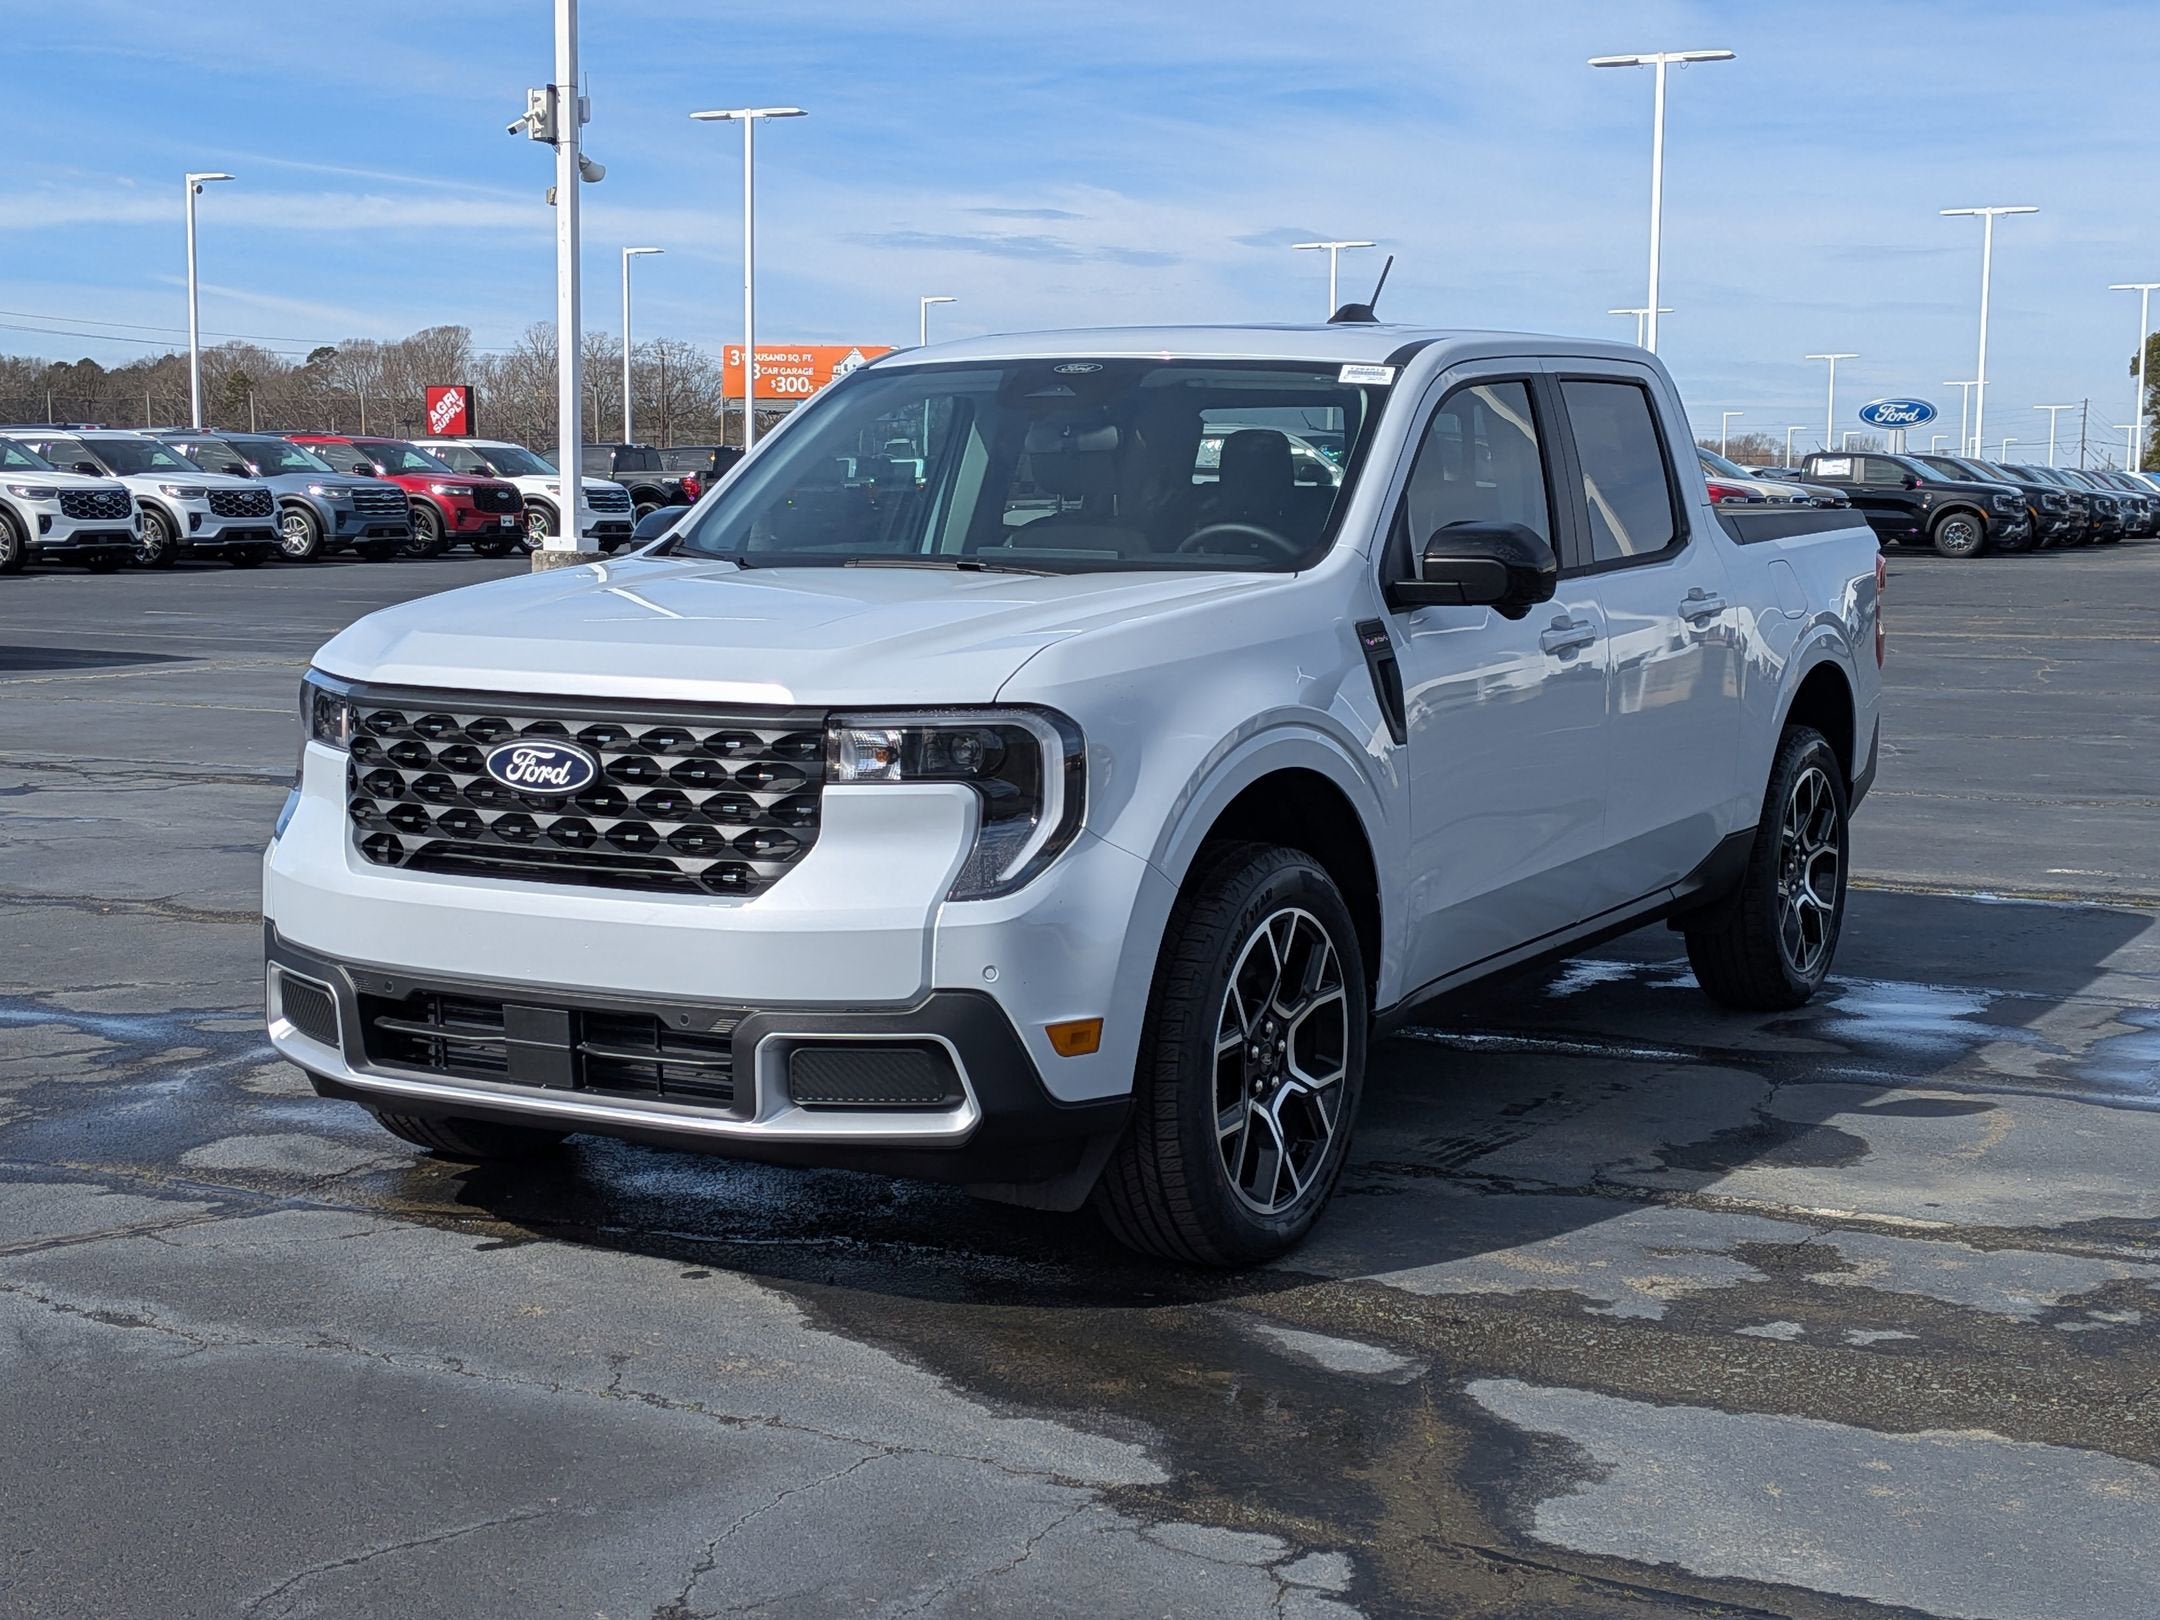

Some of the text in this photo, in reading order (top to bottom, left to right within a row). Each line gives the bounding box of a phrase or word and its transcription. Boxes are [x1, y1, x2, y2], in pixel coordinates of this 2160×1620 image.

[730, 349, 814, 366] 3 TUSAND SQ. FT.
[753, 362, 814, 380] 3 CAR GARAGE
[429, 388, 459, 424] AGRI
[433, 396, 465, 434] SUPPLY
[1874, 403, 1921, 422] Ford
[505, 748, 573, 785] Ford
